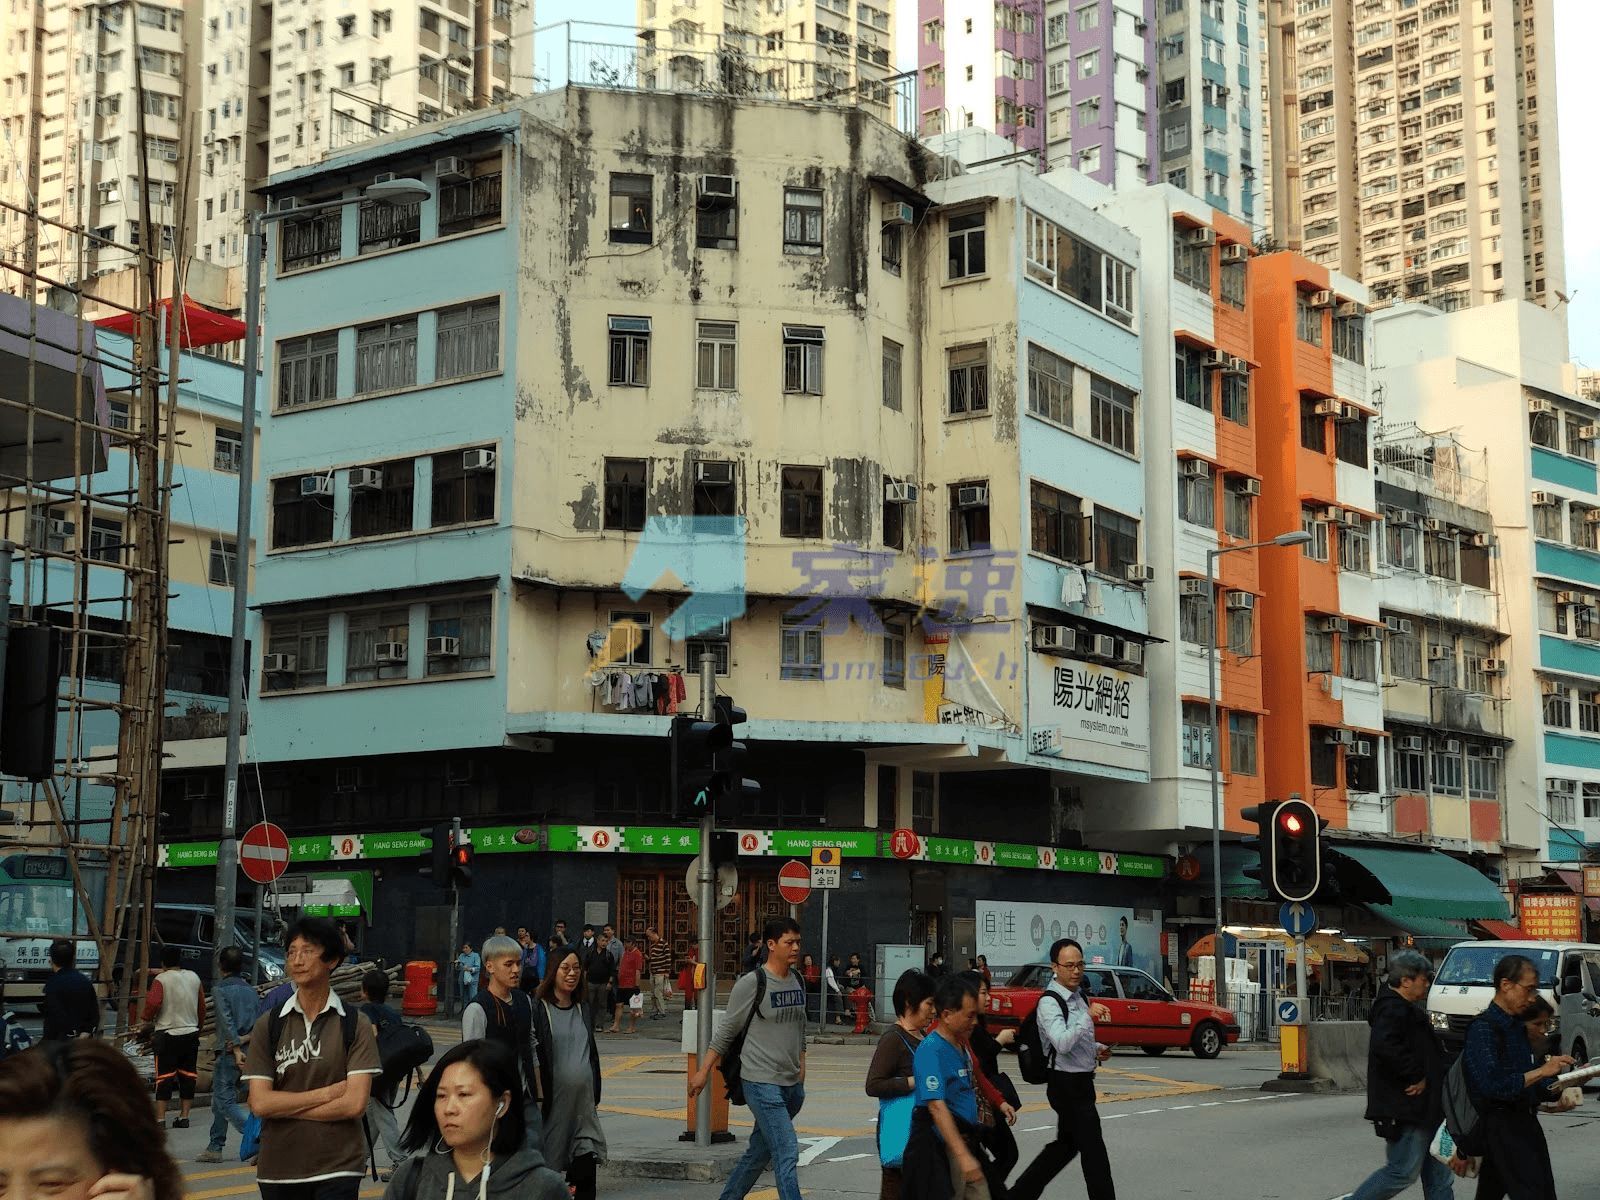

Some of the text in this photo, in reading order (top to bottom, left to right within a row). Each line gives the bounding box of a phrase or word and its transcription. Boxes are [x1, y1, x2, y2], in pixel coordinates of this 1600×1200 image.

[1053, 666, 1131, 720] 陽光網絡
[1080, 719, 1129, 738] msystem.com.hk
[373, 839, 426, 850] HANG SENG BANK
[482, 834, 517, 846] 恒生
[641, 834, 692, 847] 恒生銀
[787, 839, 858, 848] HANG SENG BANK
[177, 850, 219, 859] HANG SENG BAN
[935, 844, 969, 858] 恒生銀行
[817, 876, 834, 886] 全日
[981, 910, 1016, 947] 優進
